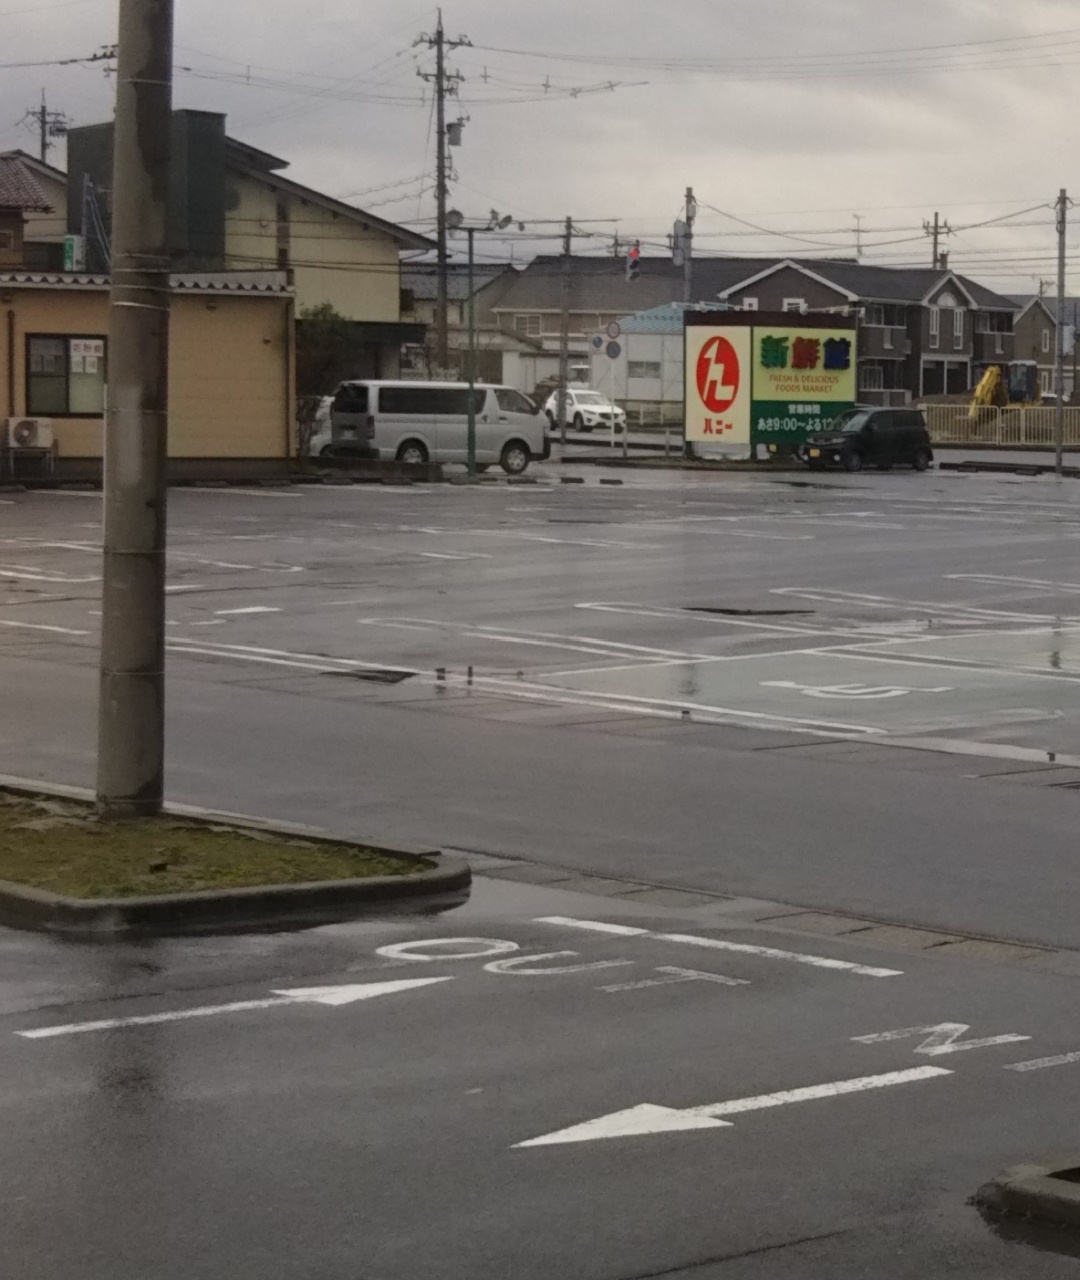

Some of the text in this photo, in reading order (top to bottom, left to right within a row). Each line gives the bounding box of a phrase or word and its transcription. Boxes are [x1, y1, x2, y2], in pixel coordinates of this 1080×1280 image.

[794, 375, 800, 383] &
[801, 375, 839, 384] DELICIOUS
[775, 384, 833, 393] FOODS MARKET
[703, 418, 733, 435] ハニー
[375, 936, 751, 994] OUT
